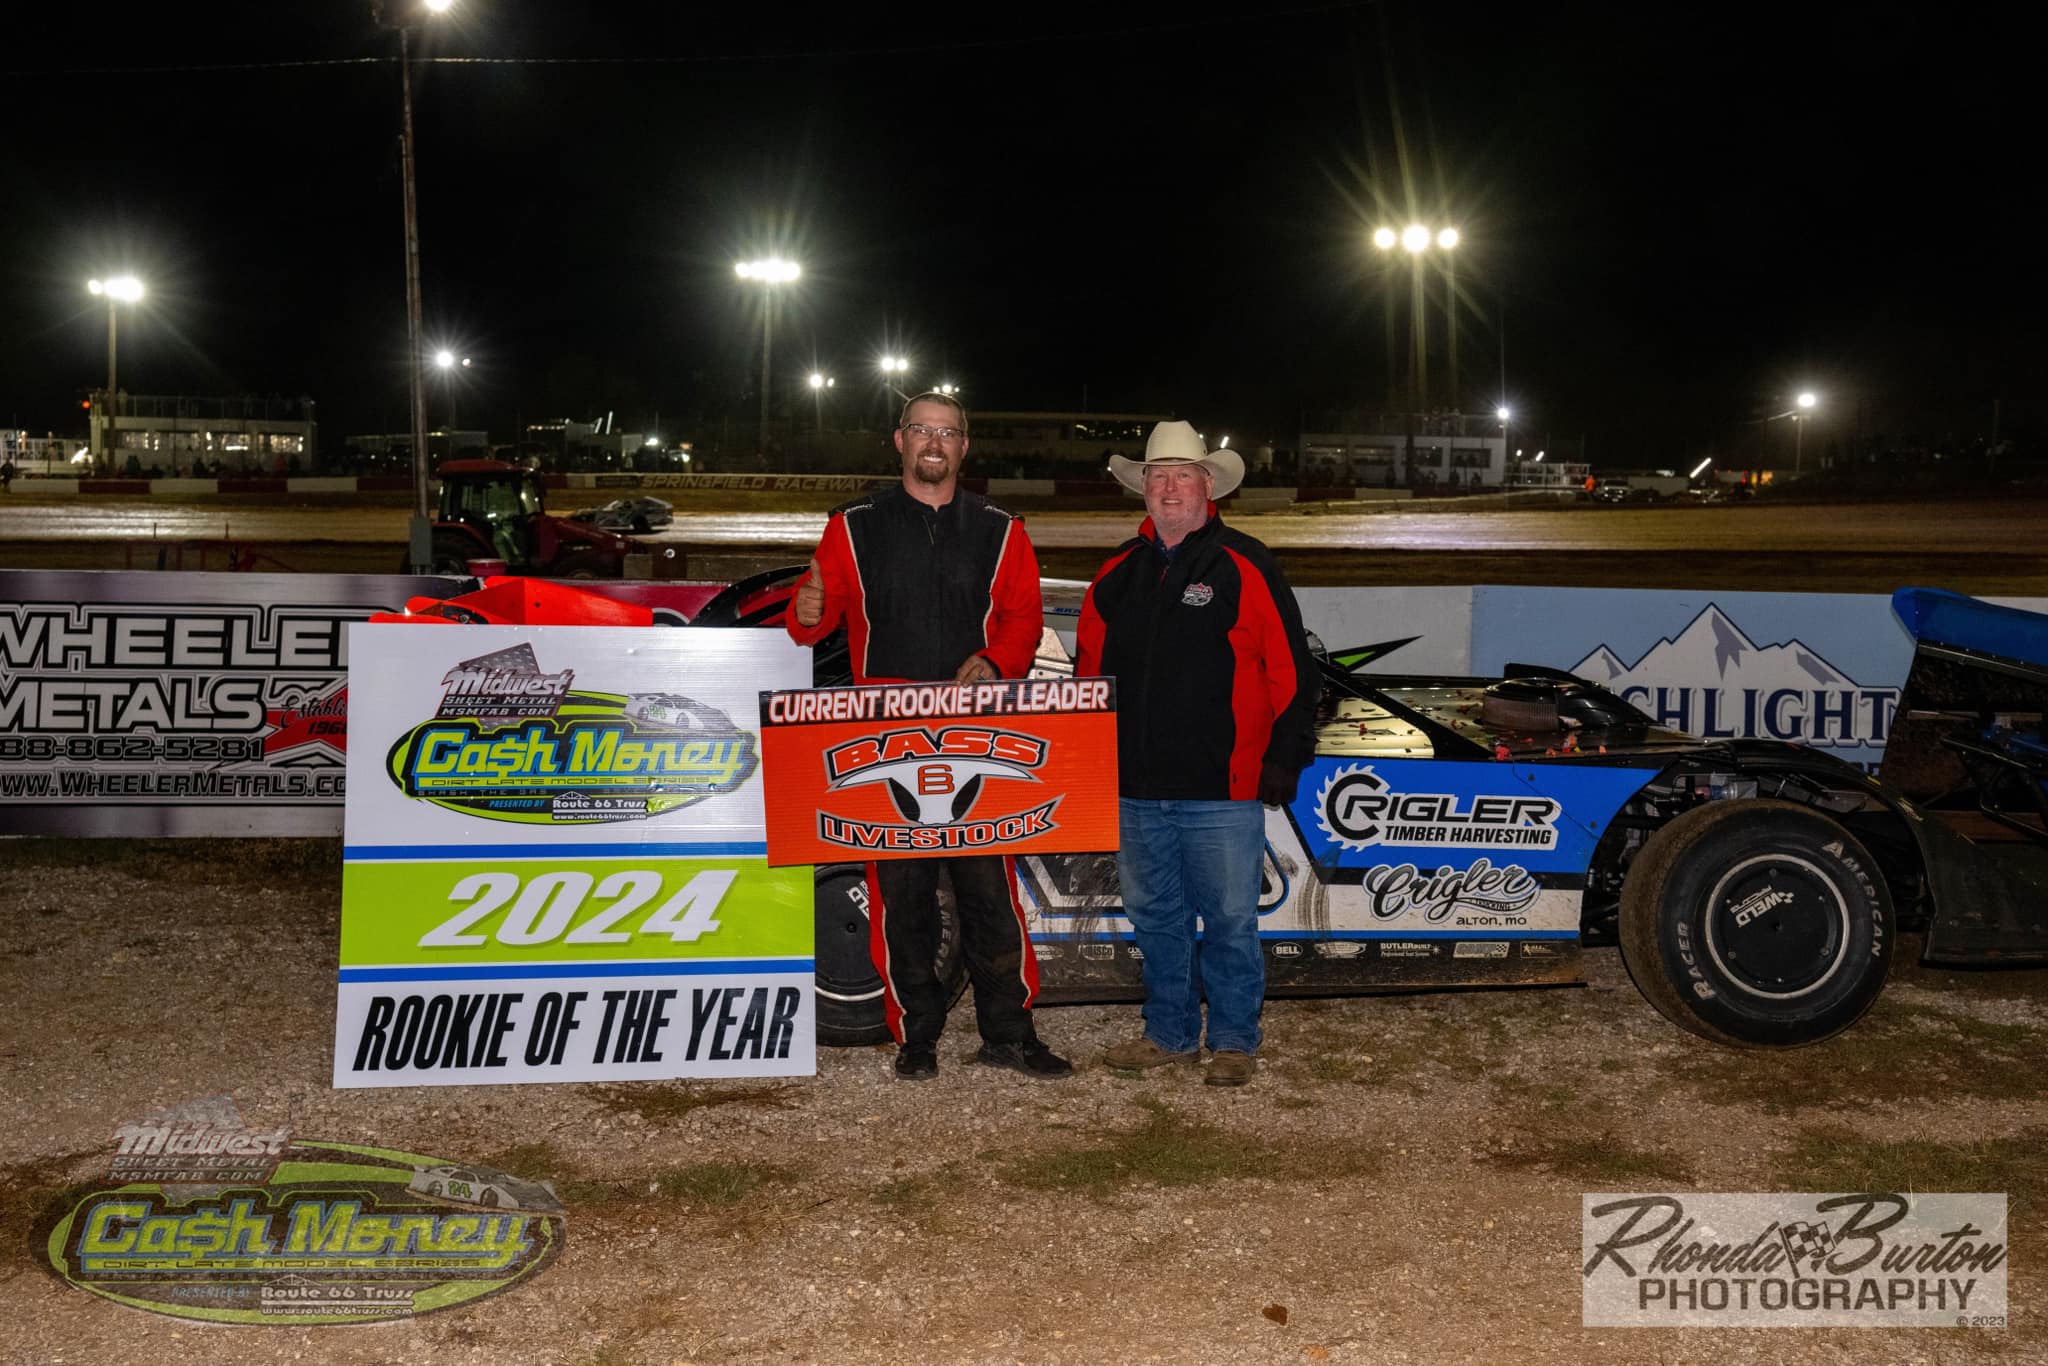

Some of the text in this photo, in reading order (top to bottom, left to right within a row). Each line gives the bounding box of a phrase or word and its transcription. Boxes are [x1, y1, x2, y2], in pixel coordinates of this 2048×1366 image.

[641, 475, 766, 489] SPRINGFIELD
[774, 477, 868, 491] RACEWAY
[0, 616, 348, 667] WHEELE
[444, 696, 556, 705] SHEET METAL
[448, 670, 573, 695] Midwest
[769, 680, 1110, 723] CURRENT ROOKIE PT. LEADER
[308, 721, 347, 735] 196
[414, 729, 559, 777] Ca$h
[832, 729, 1043, 776] BASS
[489, 799, 545, 808] PRESENTED BY
[553, 799, 646, 809] Route 66 Truss
[1326, 773, 1555, 840] CRIGLER
[824, 806, 1052, 848] LIVESTOCK
[1385, 825, 1552, 845] TIMBER HARVESTING
[417, 869, 740, 949] 2024
[1366, 859, 1533, 920] Crigler
[1736, 892, 1783, 927] WELD
[1822, 840, 1885, 957] AMERICAN
[1275, 946, 1300, 955] BELL
[352, 986, 801, 1071] ROOKIE OF THE YEAR
